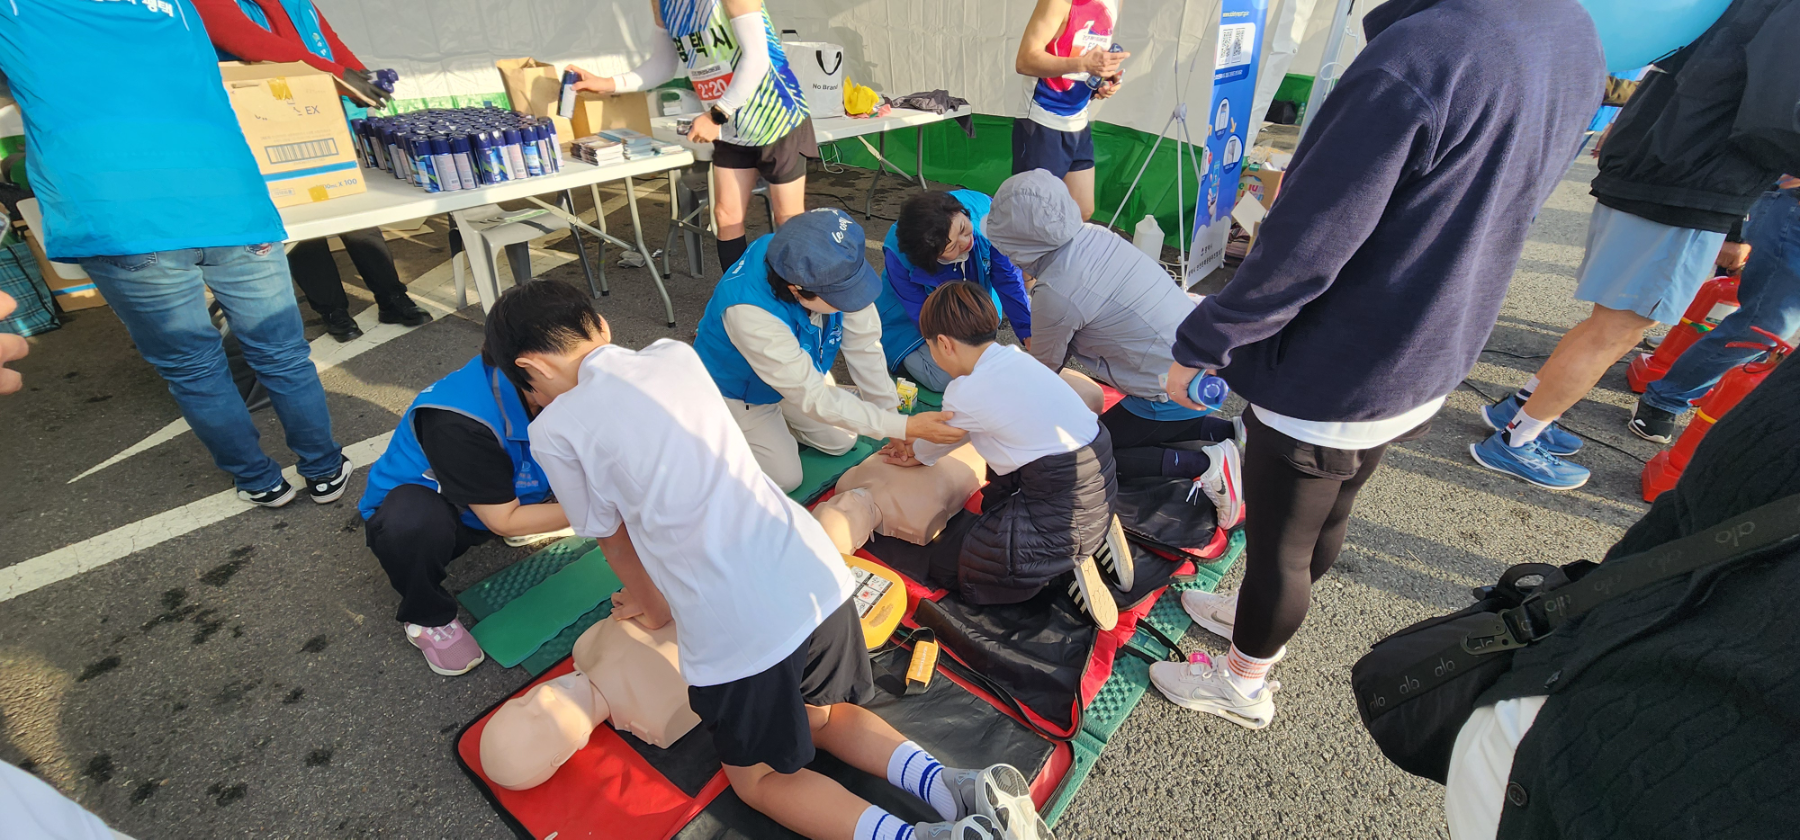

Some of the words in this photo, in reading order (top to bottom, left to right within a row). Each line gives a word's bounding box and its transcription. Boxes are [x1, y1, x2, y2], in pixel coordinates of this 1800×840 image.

[304, 105, 320, 115] EX
[344, 178, 358, 186] 100
[1400, 675, 1421, 695] alo
[1434, 658, 1456, 677] alo
